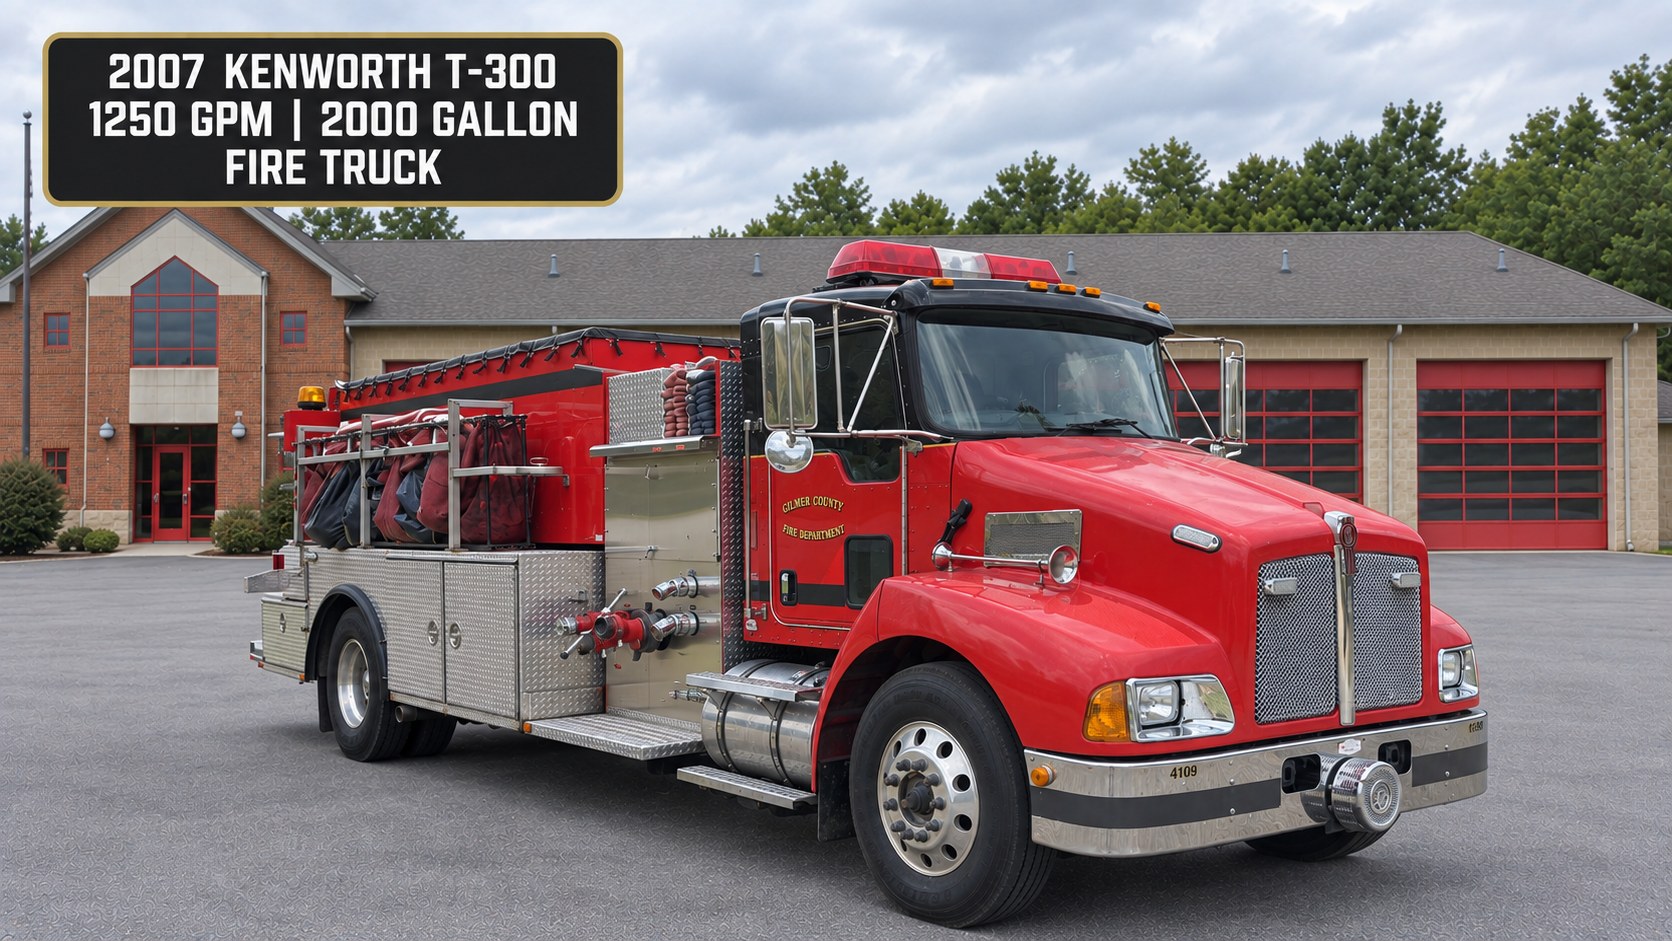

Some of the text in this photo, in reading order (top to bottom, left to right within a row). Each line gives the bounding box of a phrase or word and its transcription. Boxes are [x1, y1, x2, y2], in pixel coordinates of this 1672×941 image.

[782, 496, 844, 513] GILMER COUNTY
[782, 524, 845, 540] FIRE DEPARTMENT
[1170, 765, 1198, 779] 4109
